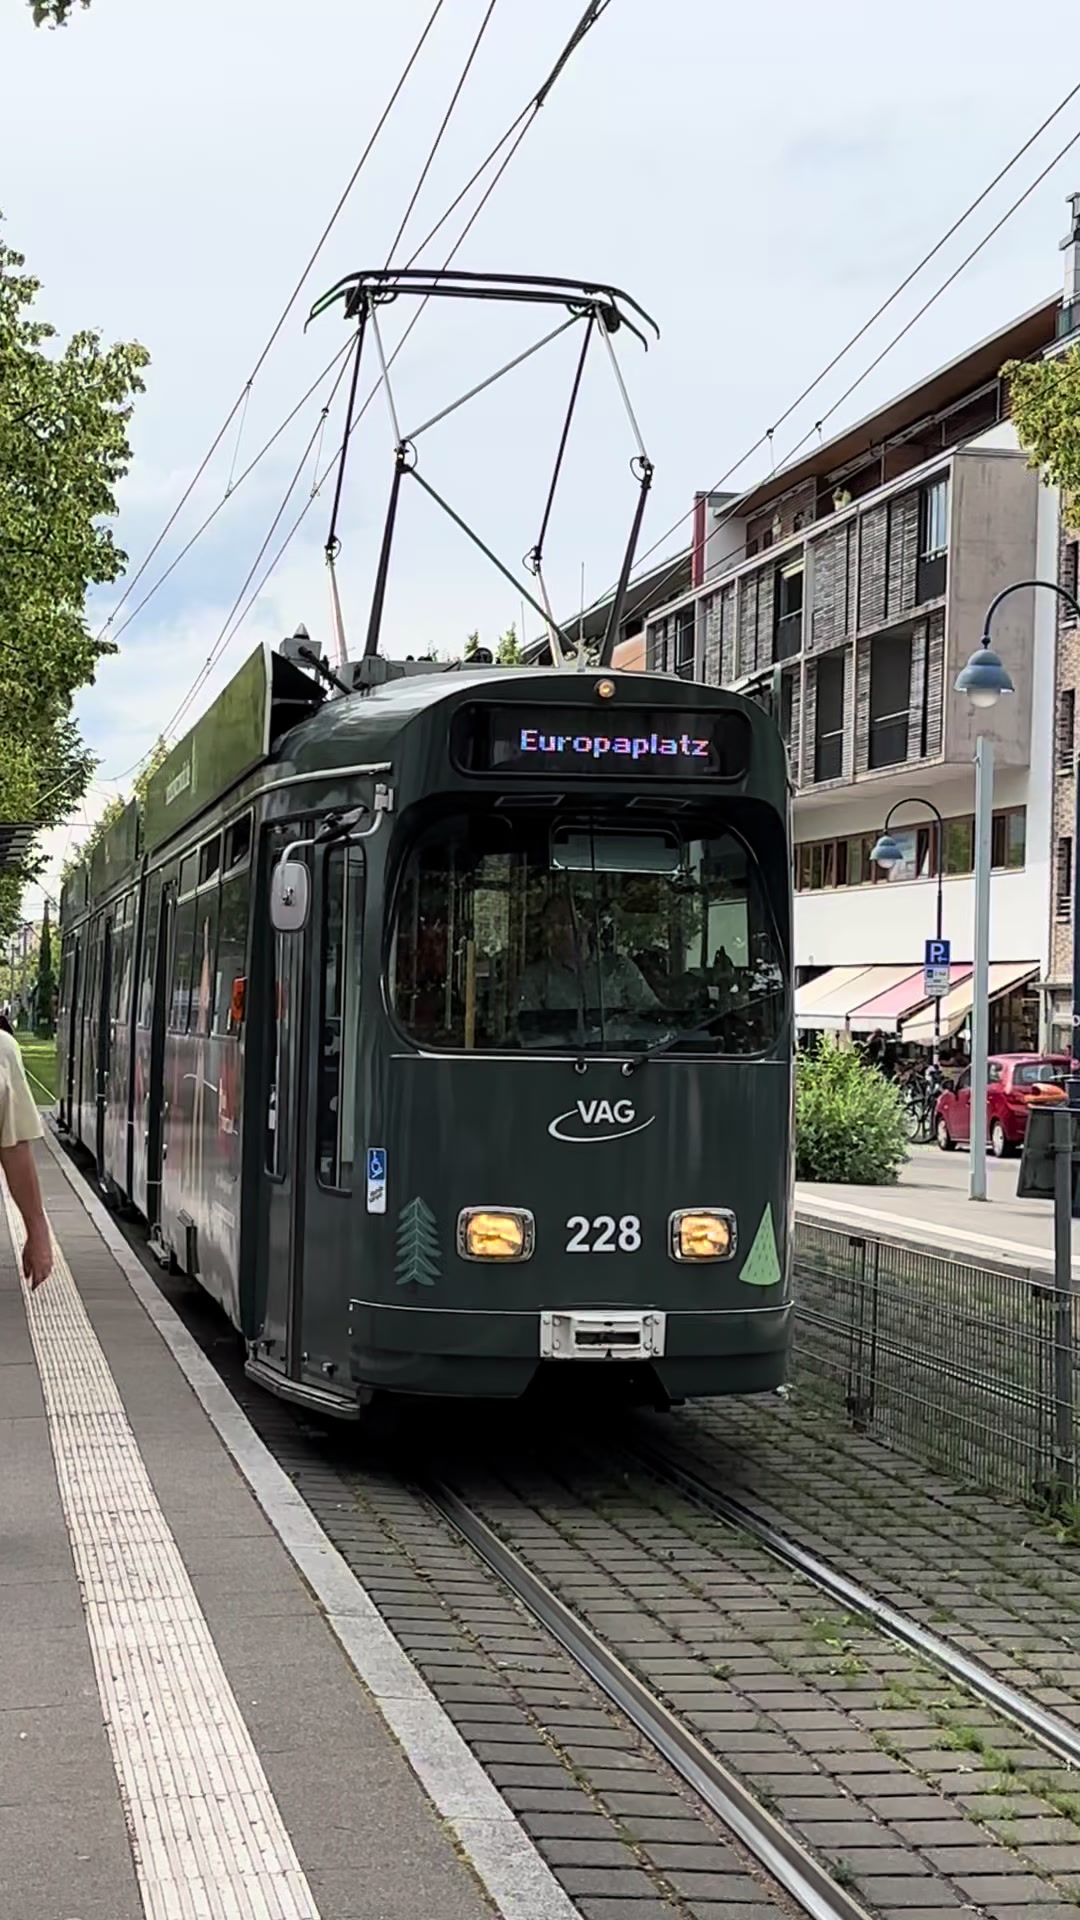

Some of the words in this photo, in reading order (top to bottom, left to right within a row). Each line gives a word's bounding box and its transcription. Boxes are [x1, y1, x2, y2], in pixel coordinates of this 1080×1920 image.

[520, 729, 709, 759] Europaplatz
[930, 943, 945, 963] P
[577, 1100, 635, 1124] VAG
[566, 1215, 642, 1252] 228
